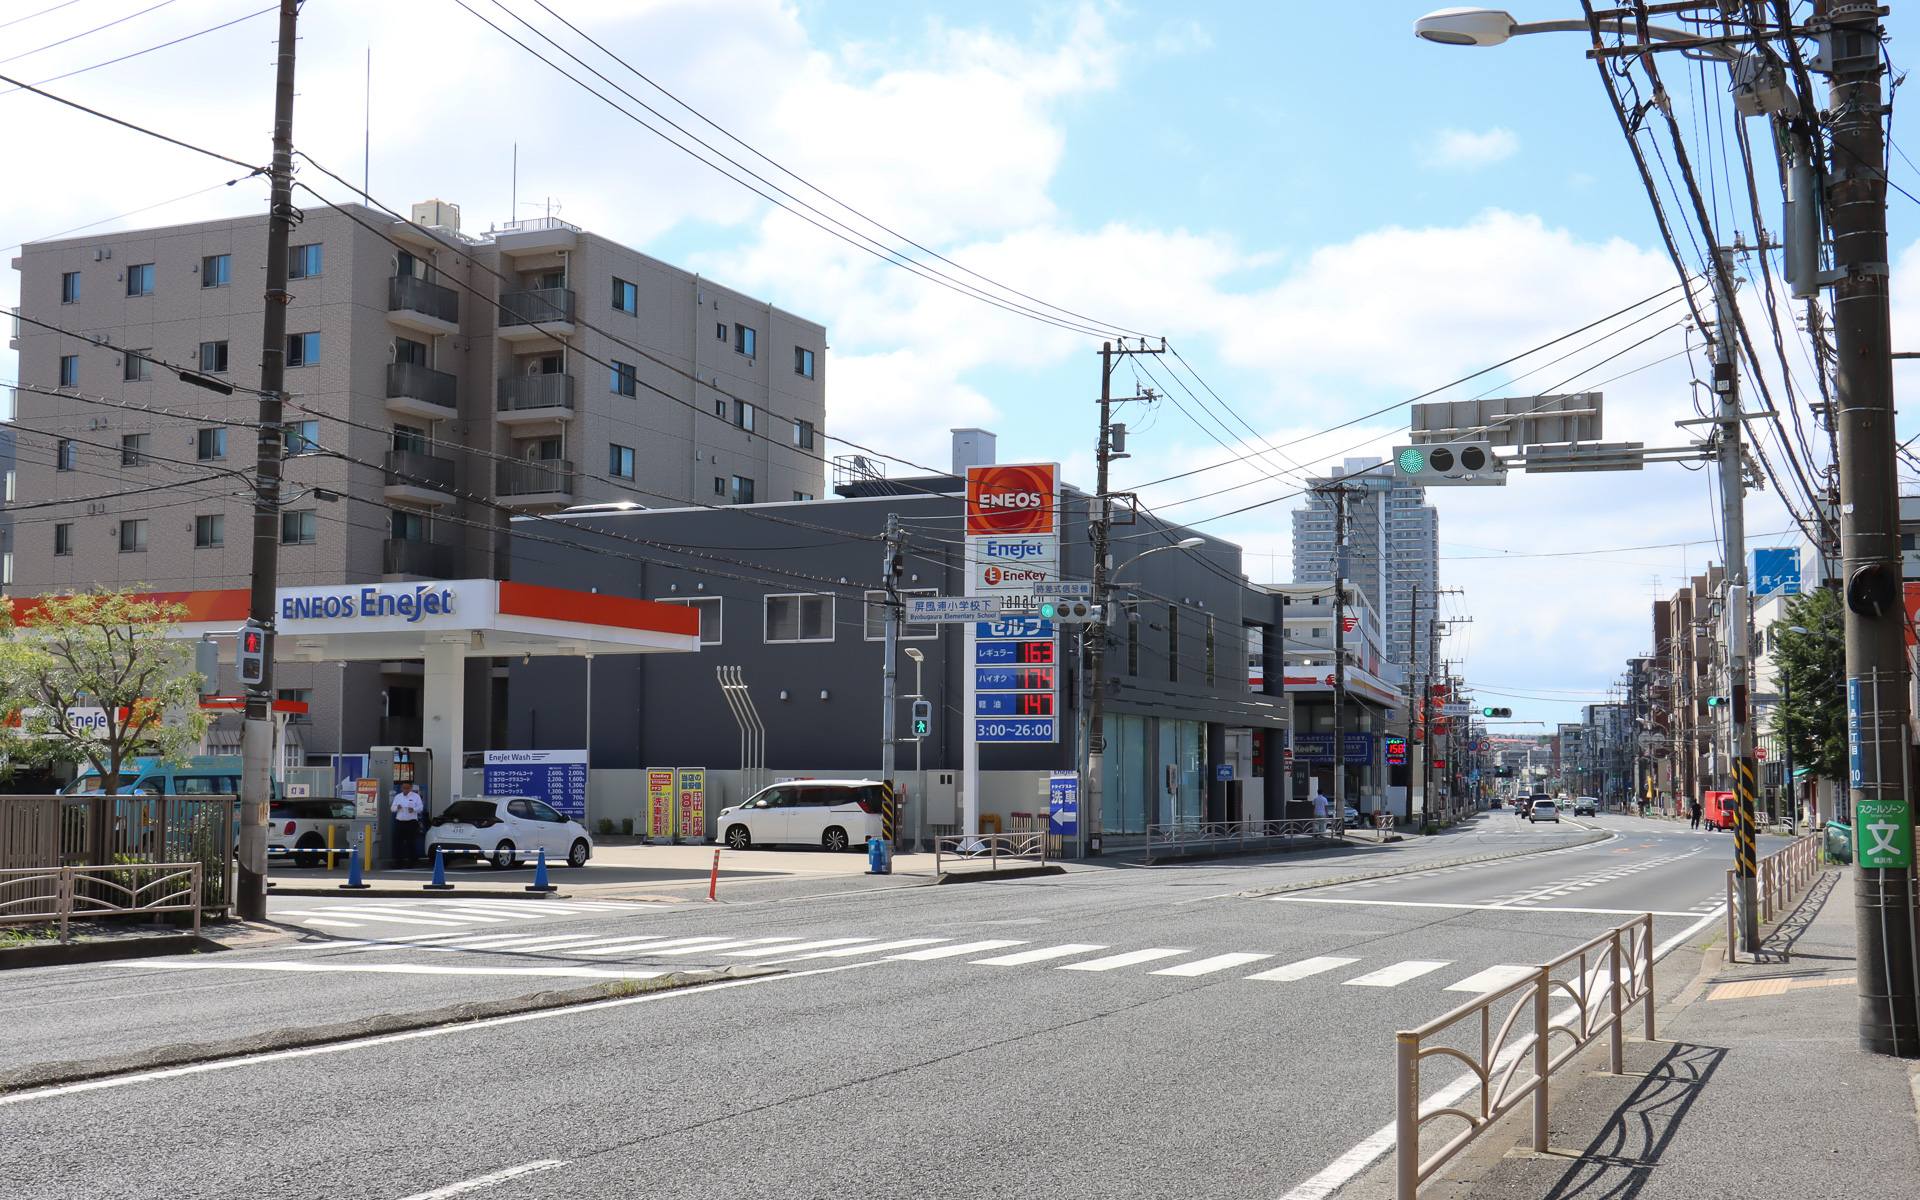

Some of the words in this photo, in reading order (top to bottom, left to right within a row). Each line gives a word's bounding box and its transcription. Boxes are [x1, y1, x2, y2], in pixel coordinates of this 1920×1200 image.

[979, 492, 1041, 508] ENEOS
[1003, 570, 1046, 581] EneKey
[1761, 575, 1800, 585] 真イエ
[1036, 585, 1088, 593] 時差式信号機
[282, 596, 355, 619] ENEOS
[914, 600, 992, 612] 屏風浦小学校下
[910, 613, 943, 621] Byobugaura
[944, 612, 975, 620] Elementary
[988, 618, 1042, 636] セルフ
[979, 649, 1013, 657] レギュラー
[1025, 643, 1053, 663] 163
[979, 675, 1007, 683] ハイオク
[1025, 669, 1053, 688] 174
[979, 700, 1001, 708] 軽油
[1025, 695, 1053, 714] 147
[1389, 744, 1404, 754] 158
[512, 753, 531, 761] Wash
[1851, 770, 1860, 781] 10
[1051, 790, 1076, 804] 洗車
[681, 792, 692, 835] 8円引
[1860, 804, 1905, 813] スクールゾーン
[653, 796, 663, 835] 洗車割引
